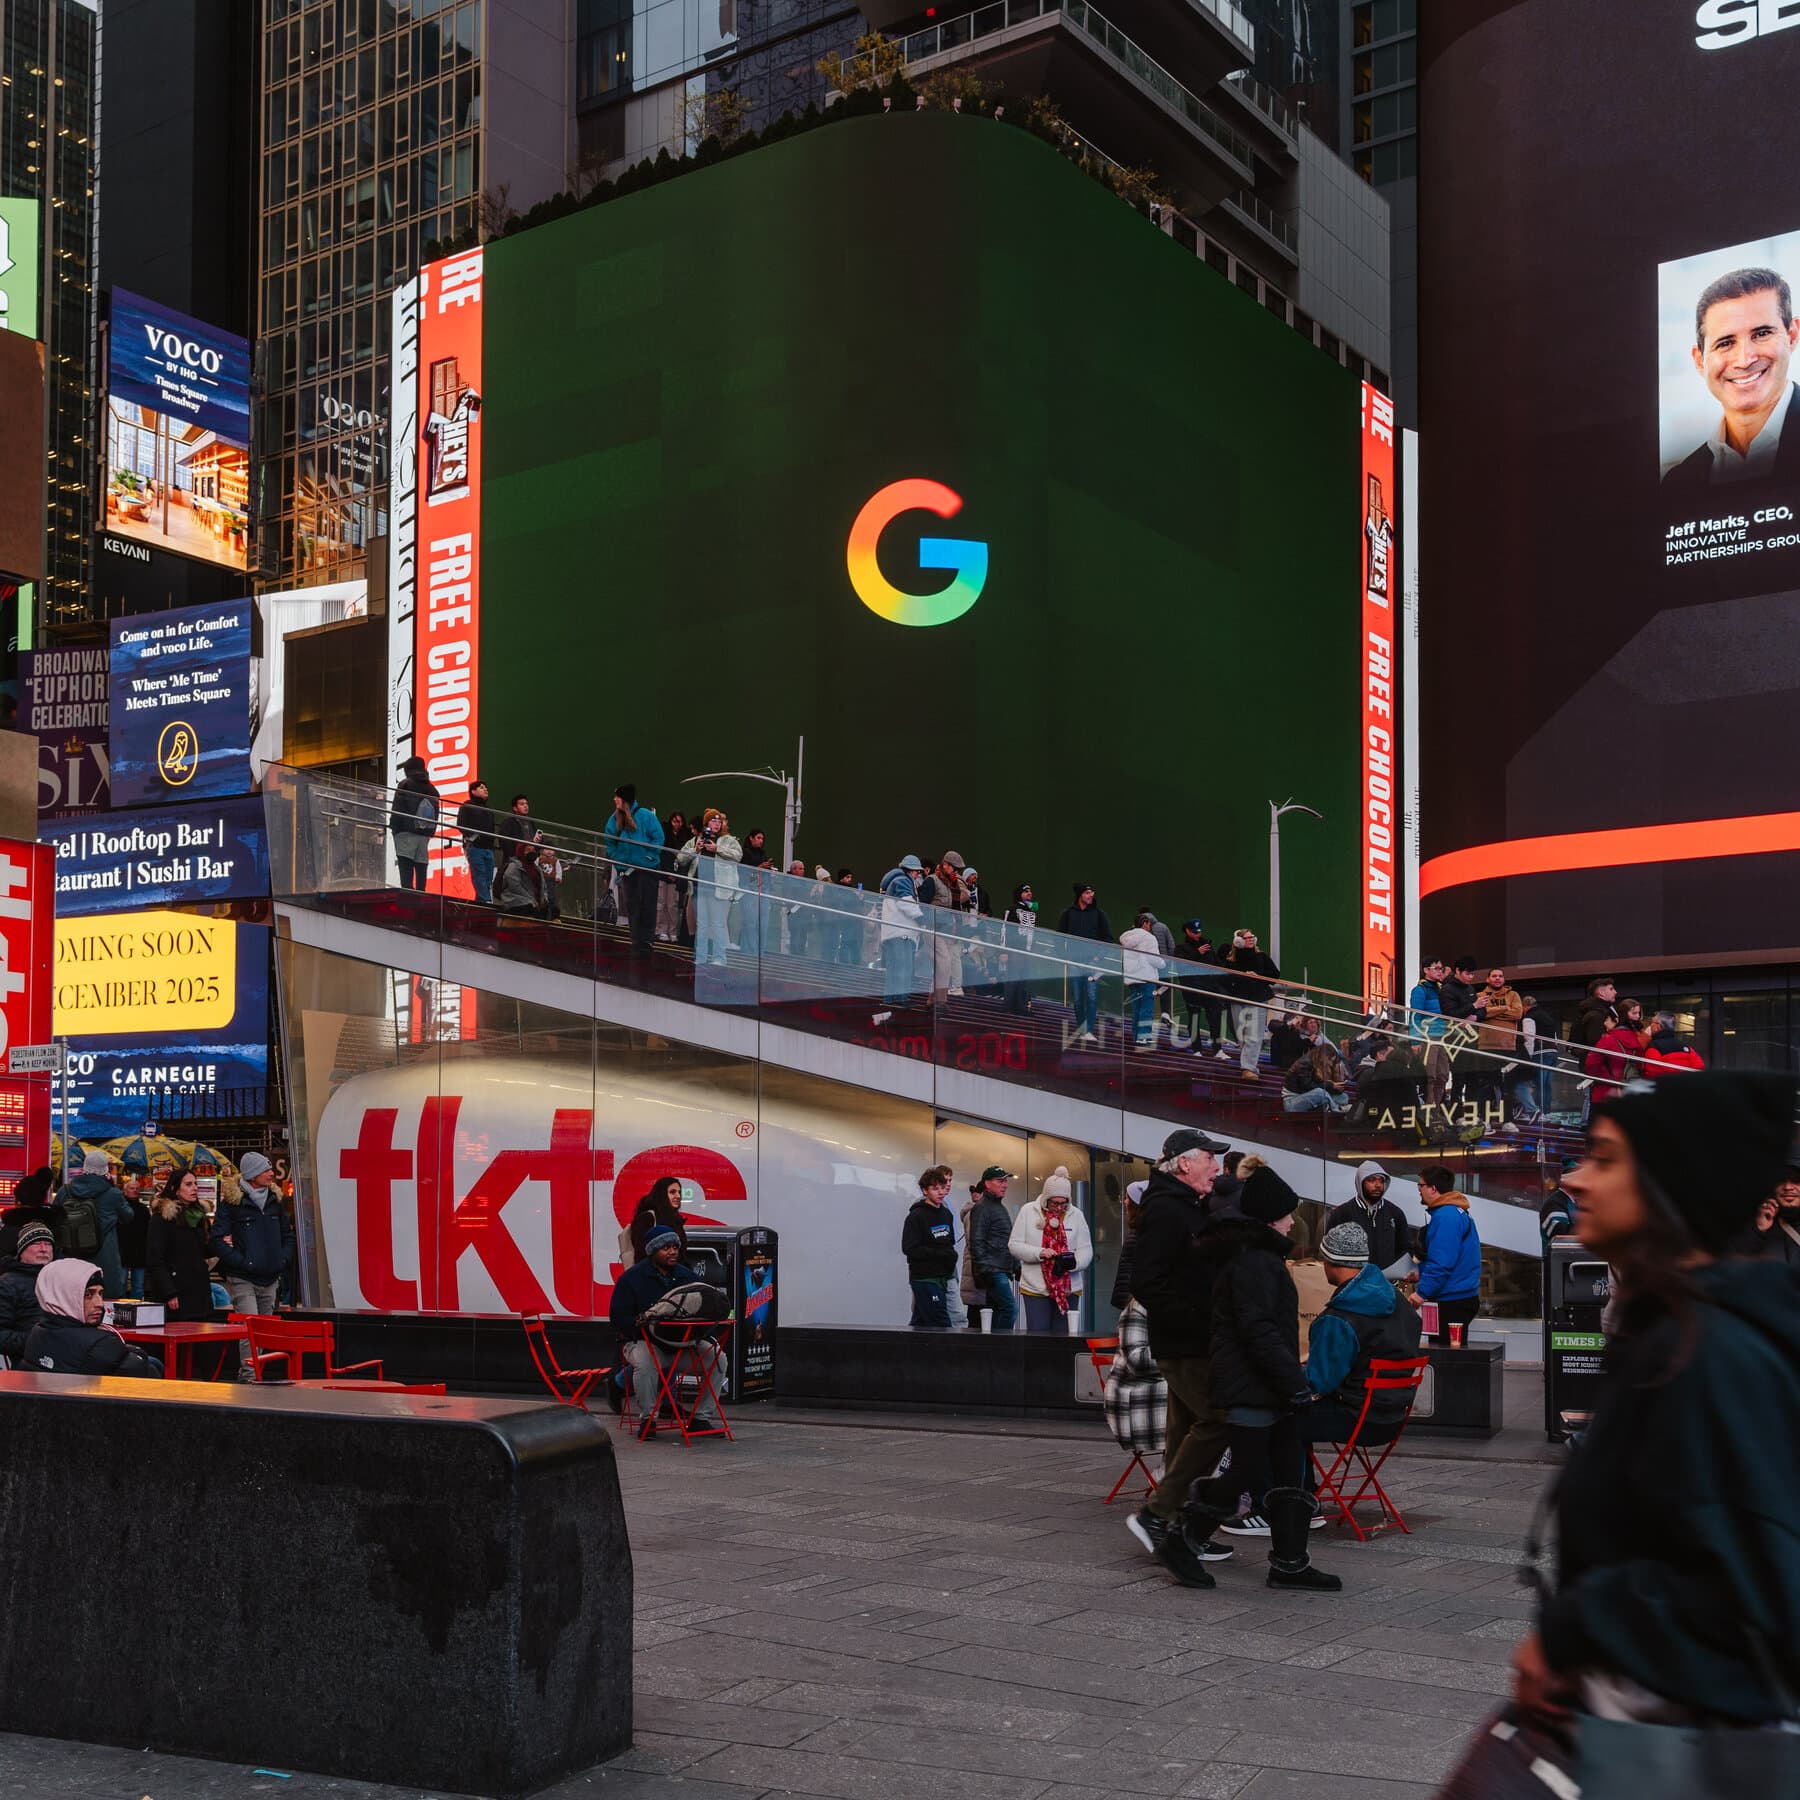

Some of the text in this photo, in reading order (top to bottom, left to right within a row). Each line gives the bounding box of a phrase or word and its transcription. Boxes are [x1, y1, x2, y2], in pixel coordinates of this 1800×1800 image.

[438, 253, 484, 315] RE
[166, 361, 197, 381] BY IHG
[154, 374, 209, 402] Times Square
[161, 389, 201, 413] Broadway
[1370, 395, 1393, 448] RE
[1665, 506, 1793, 539] Jeff Marks, CEO,
[104, 537, 150, 562] KEVANI
[847, 478, 988, 627] G
[1666, 528, 1747, 552] INNOVATIVE
[1666, 540, 1764, 566] PARTNERSHIPS
[429, 532, 472, 632] FREE
[120, 615, 239, 643] Come on in for Comfort
[141, 636, 214, 658] and voco Life.
[125, 688, 231, 711] Meets Times Square
[132, 678, 167, 693] Where
[32, 702, 109, 730] CELEBRATIO
[1368, 630, 1391, 934] FREE CHOCOLATE
[53, 834, 77, 858] tel
[91, 827, 172, 856] Rooftop
[177, 823, 214, 847] Bar
[56, 867, 122, 892] taurant
[137, 857, 191, 885] Sushi
[197, 856, 234, 880] Bar
[142, 927, 215, 958] SOON
[166, 976, 220, 1005] 2025
[112, 1065, 216, 1084] CARNEGIE
[113, 1085, 156, 1097] DINER
[179, 1084, 216, 1094] CAFE
[1554, 1336, 1595, 1346] TIMES
